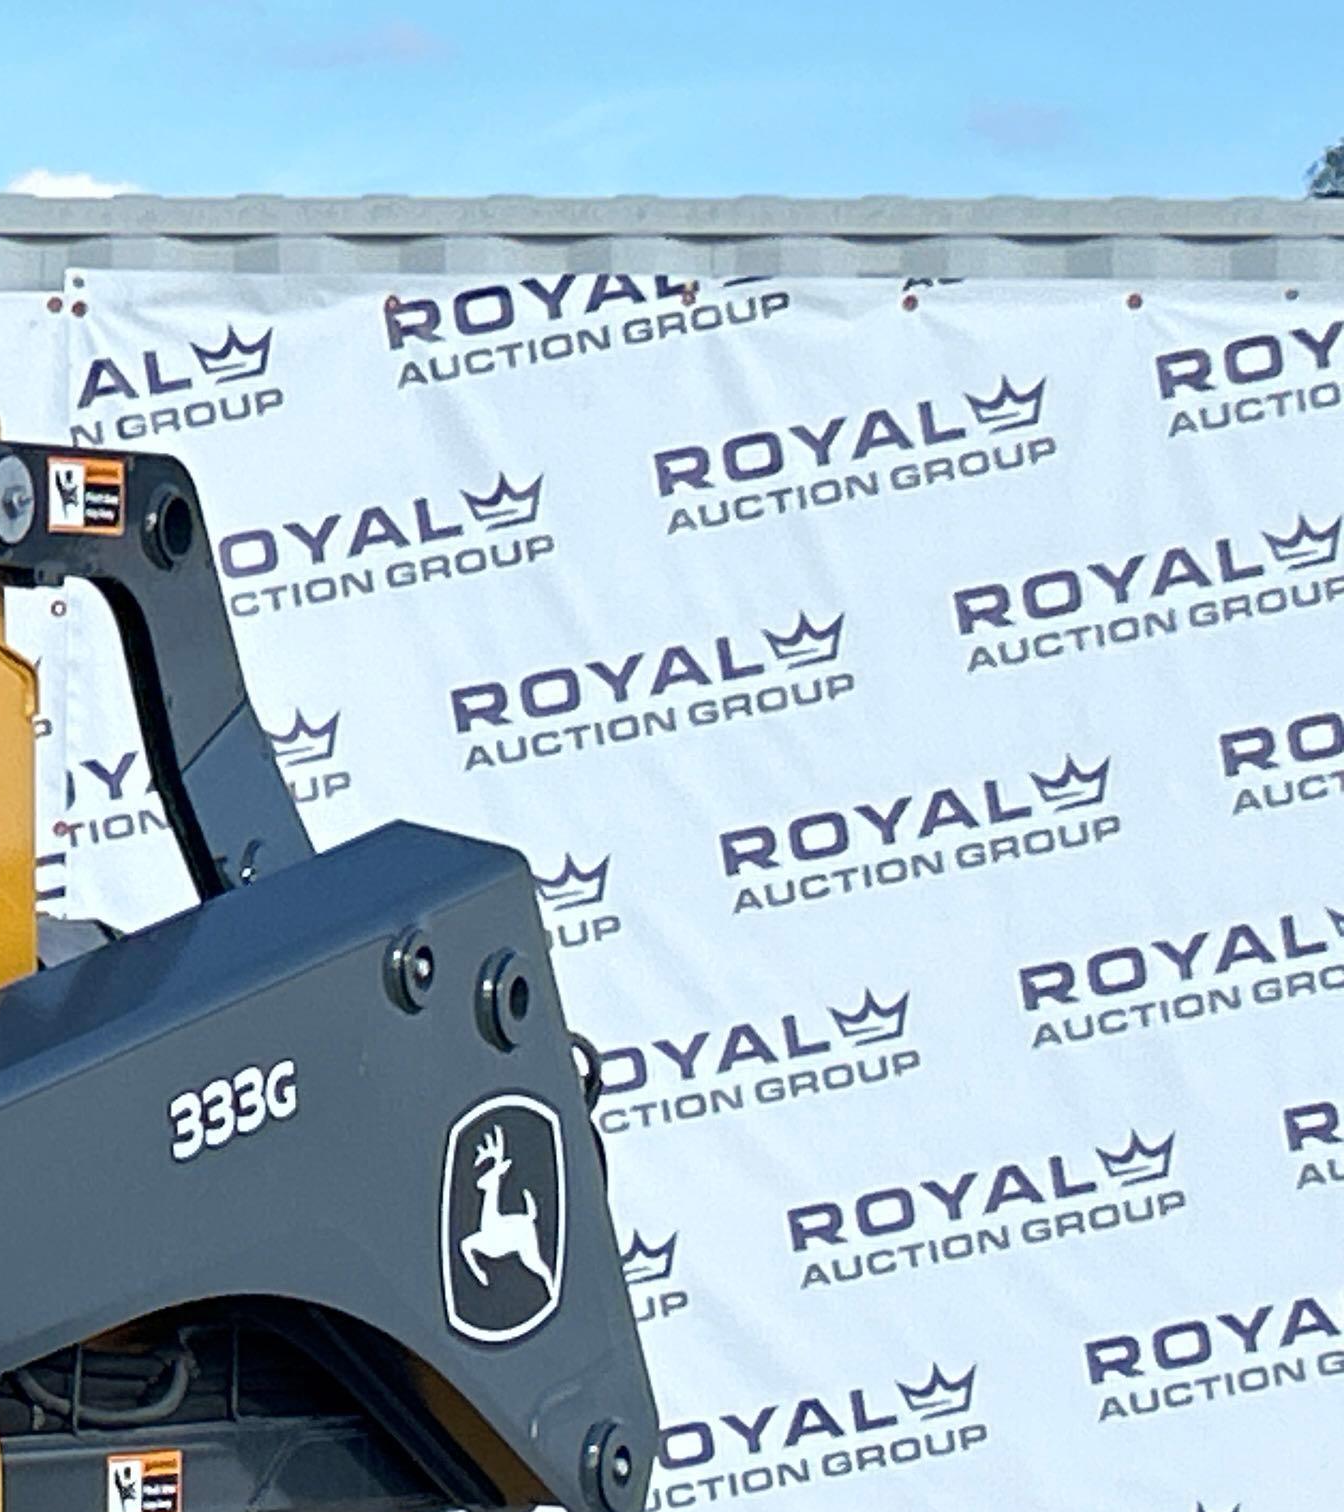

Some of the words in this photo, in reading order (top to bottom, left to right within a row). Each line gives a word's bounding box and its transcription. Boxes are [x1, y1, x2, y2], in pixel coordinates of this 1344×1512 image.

[398, 325, 612, 390] AUCTION
[621, 291, 790, 346] GROUP
[1154, 318, 1344, 401] ROY
[114, 387, 285, 442] GROUP
[653, 399, 969, 498] ROYAL
[1167, 381, 1341, 439] AUCTIO
[667, 470, 880, 536] AUCTION
[889, 437, 1058, 491] GROUP
[218, 496, 466, 579] OYAL
[230, 567, 377, 619] CTION
[385, 535, 554, 589] GROUP
[953, 537, 1267, 636] ROYAL
[967, 608, 1178, 673] AUCTION
[1187, 574, 1344, 629] GROUP
[450, 635, 767, 735] ROYAL
[464, 706, 678, 772] AUCTION
[687, 672, 856, 727] GROUP
[68, 810, 169, 848] TION
[719, 778, 1035, 878] ROYAL
[733, 849, 946, 915] AUCTION
[954, 815, 1123, 870] GROUP
[1018, 913, 1330, 1013] ROYAL
[1032, 984, 1242, 1050] AUCTION
[1251, 963, 1344, 1005] GRO
[596, 1013, 833, 1099] OYAL
[598, 1085, 745, 1138] CTION
[753, 1048, 922, 1105] GROUP
[170, 1060, 296, 1159] 333G
[786, 1153, 1100, 1254] ROYAL
[800, 1224, 1012, 1291] AUCTION
[1020, 1190, 1187, 1245] GROUP
[1083, 1295, 1343, 1387] ROYA
[653, 1387, 901, 1472] OYAL
[1097, 1357, 1307, 1424] AUCTION
[820, 1423, 989, 1478] GROUP
